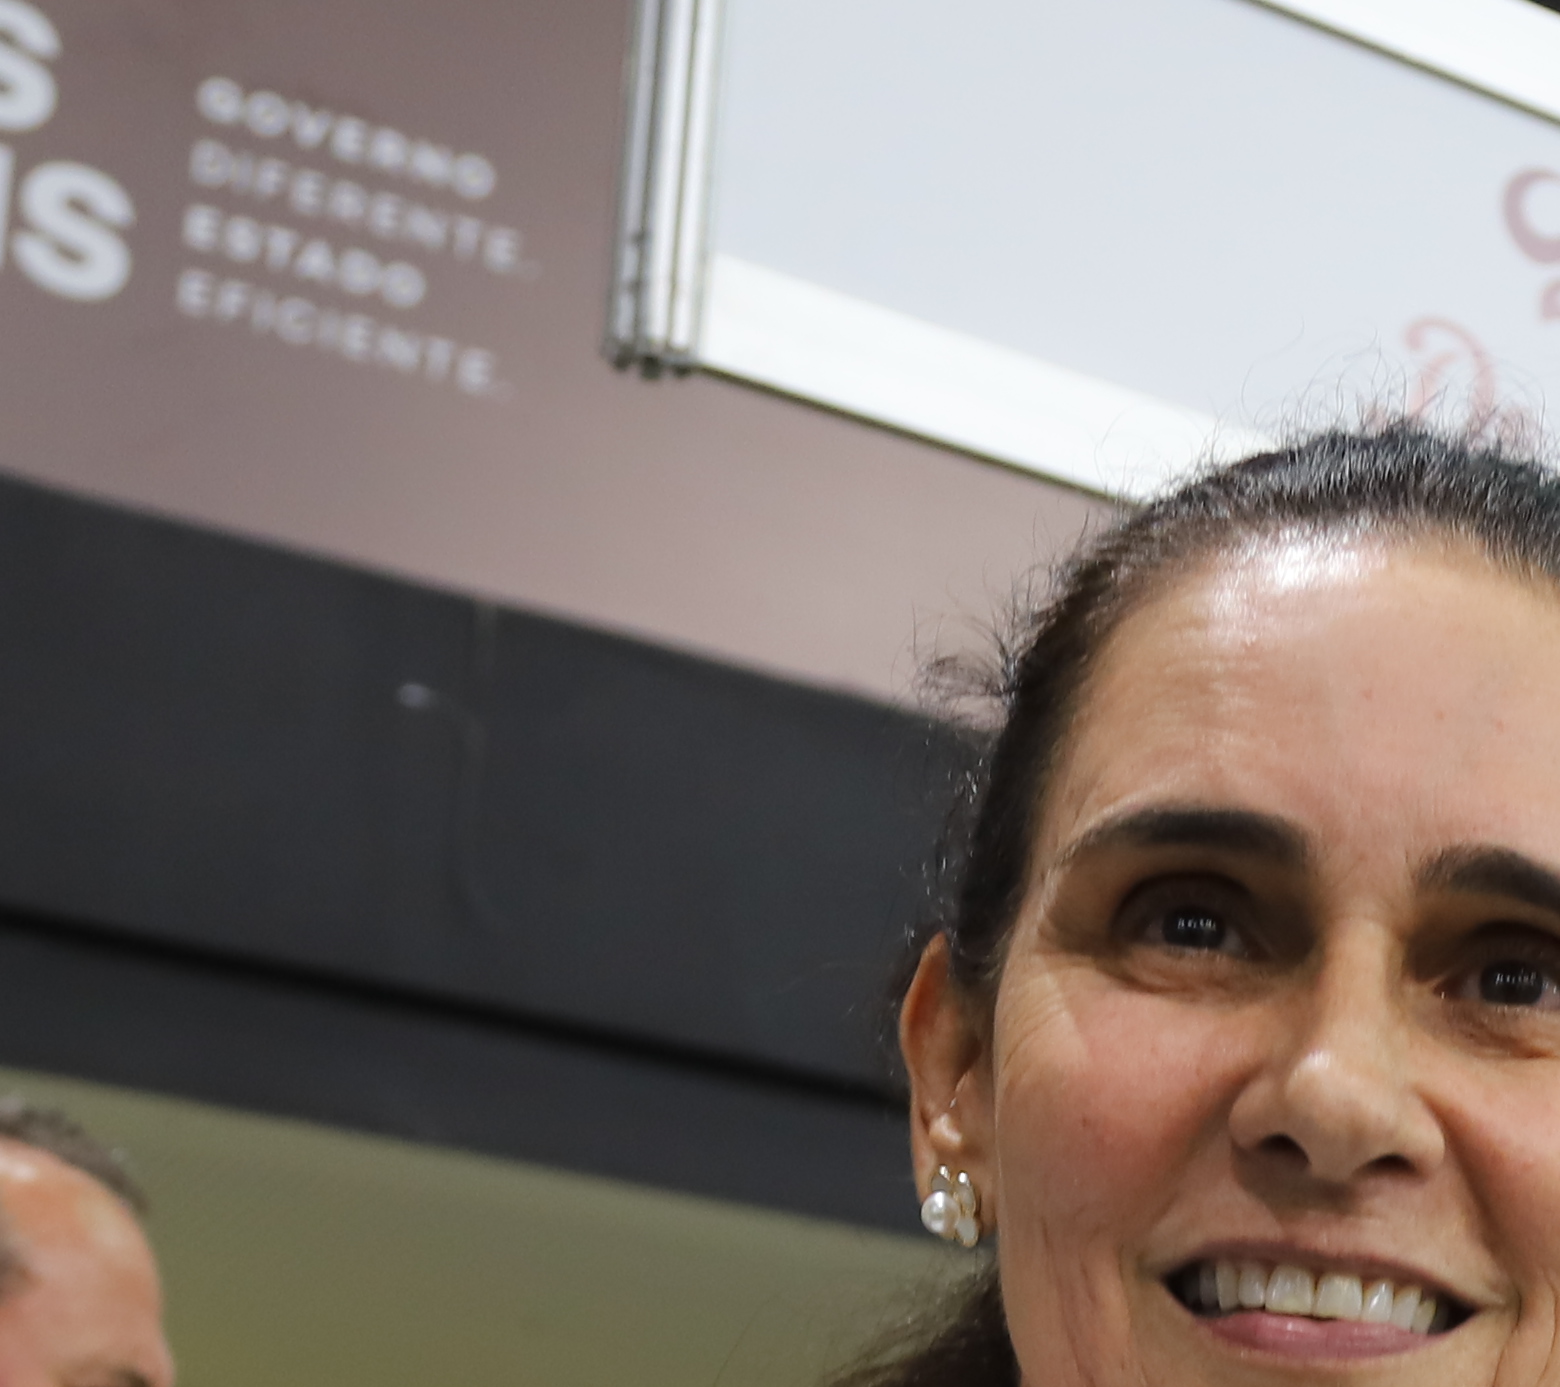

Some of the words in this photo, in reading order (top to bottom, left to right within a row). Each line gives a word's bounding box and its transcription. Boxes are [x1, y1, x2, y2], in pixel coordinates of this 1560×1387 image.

[196, 75, 497, 198] GOVERNO
[181, 202, 427, 310] ESTADO
[188, 139, 543, 284] DIFERENTE.
[175, 267, 516, 398] EFICIENTE.
